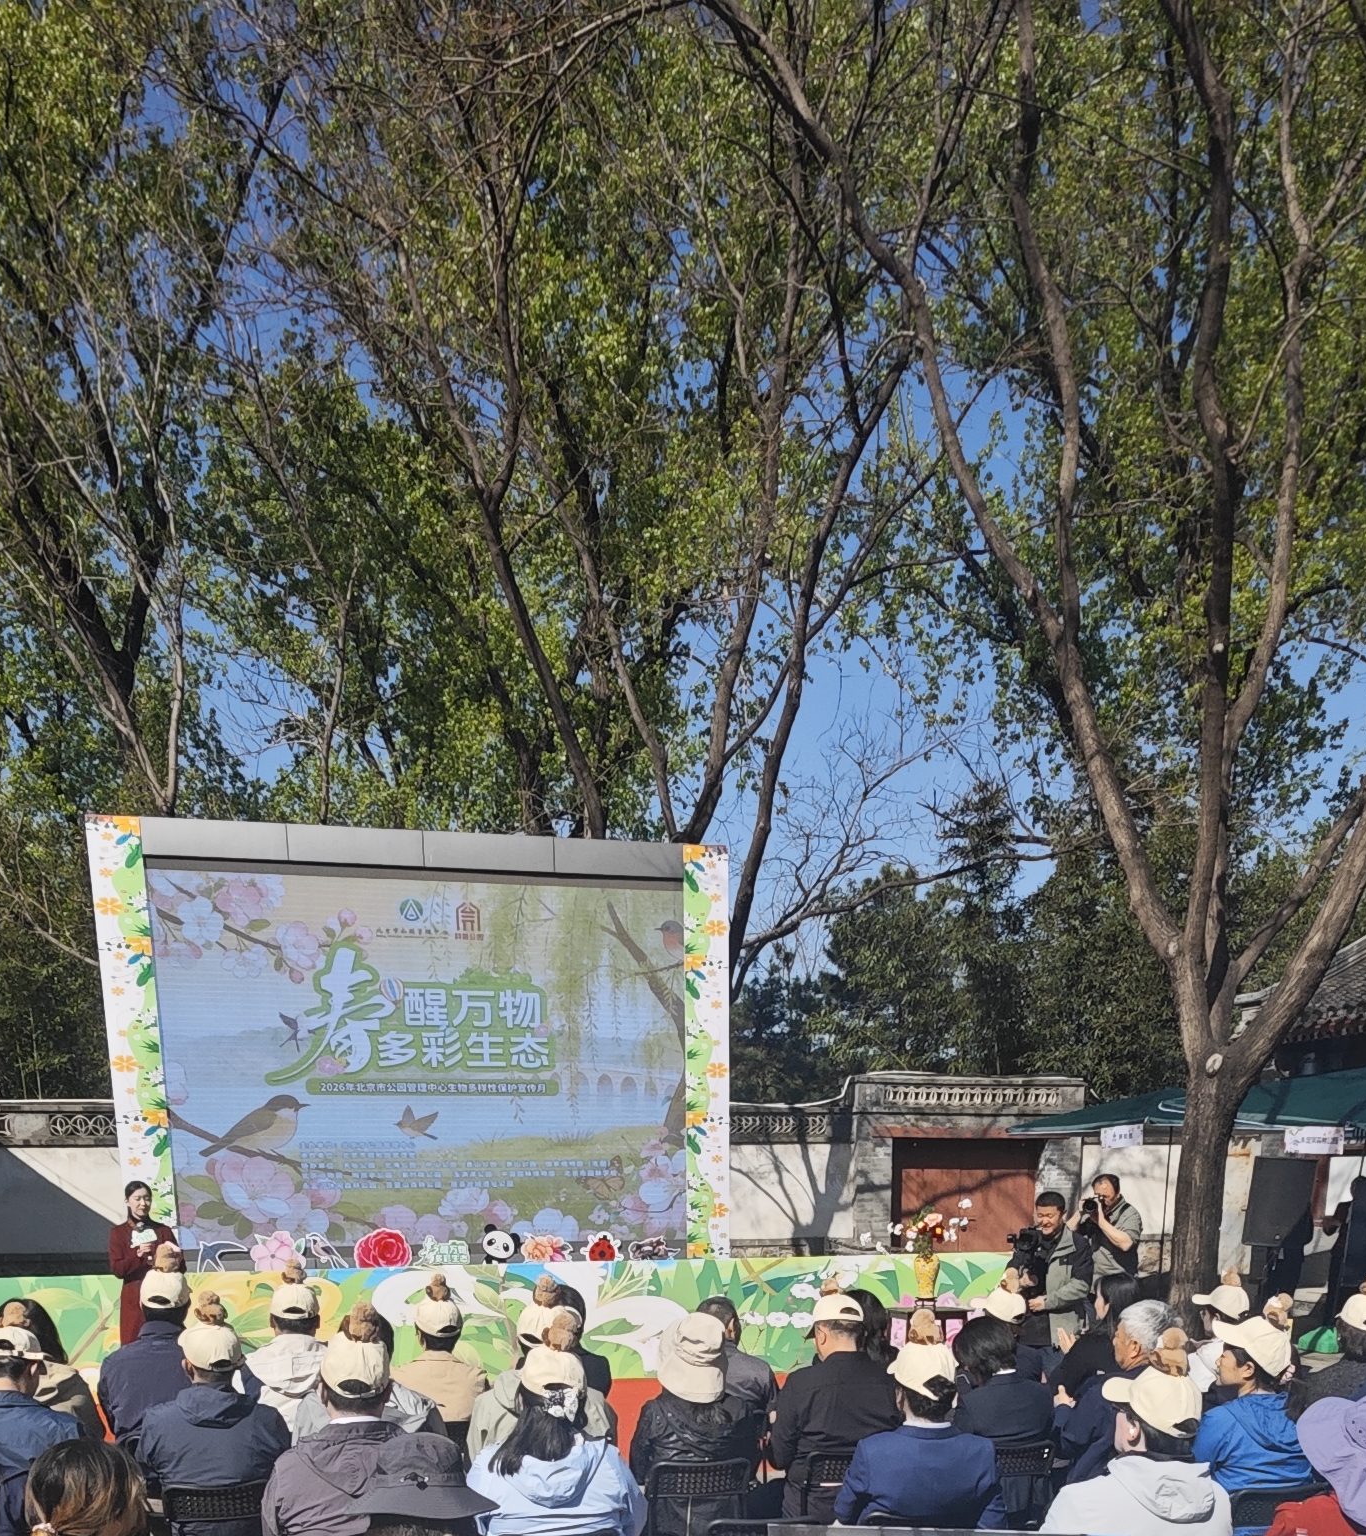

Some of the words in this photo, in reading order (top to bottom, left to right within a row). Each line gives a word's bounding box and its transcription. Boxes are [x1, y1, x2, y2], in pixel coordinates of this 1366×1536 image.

[403, 987, 542, 1029] 醒万物
[377, 1030, 551, 1069] 多彩生态
